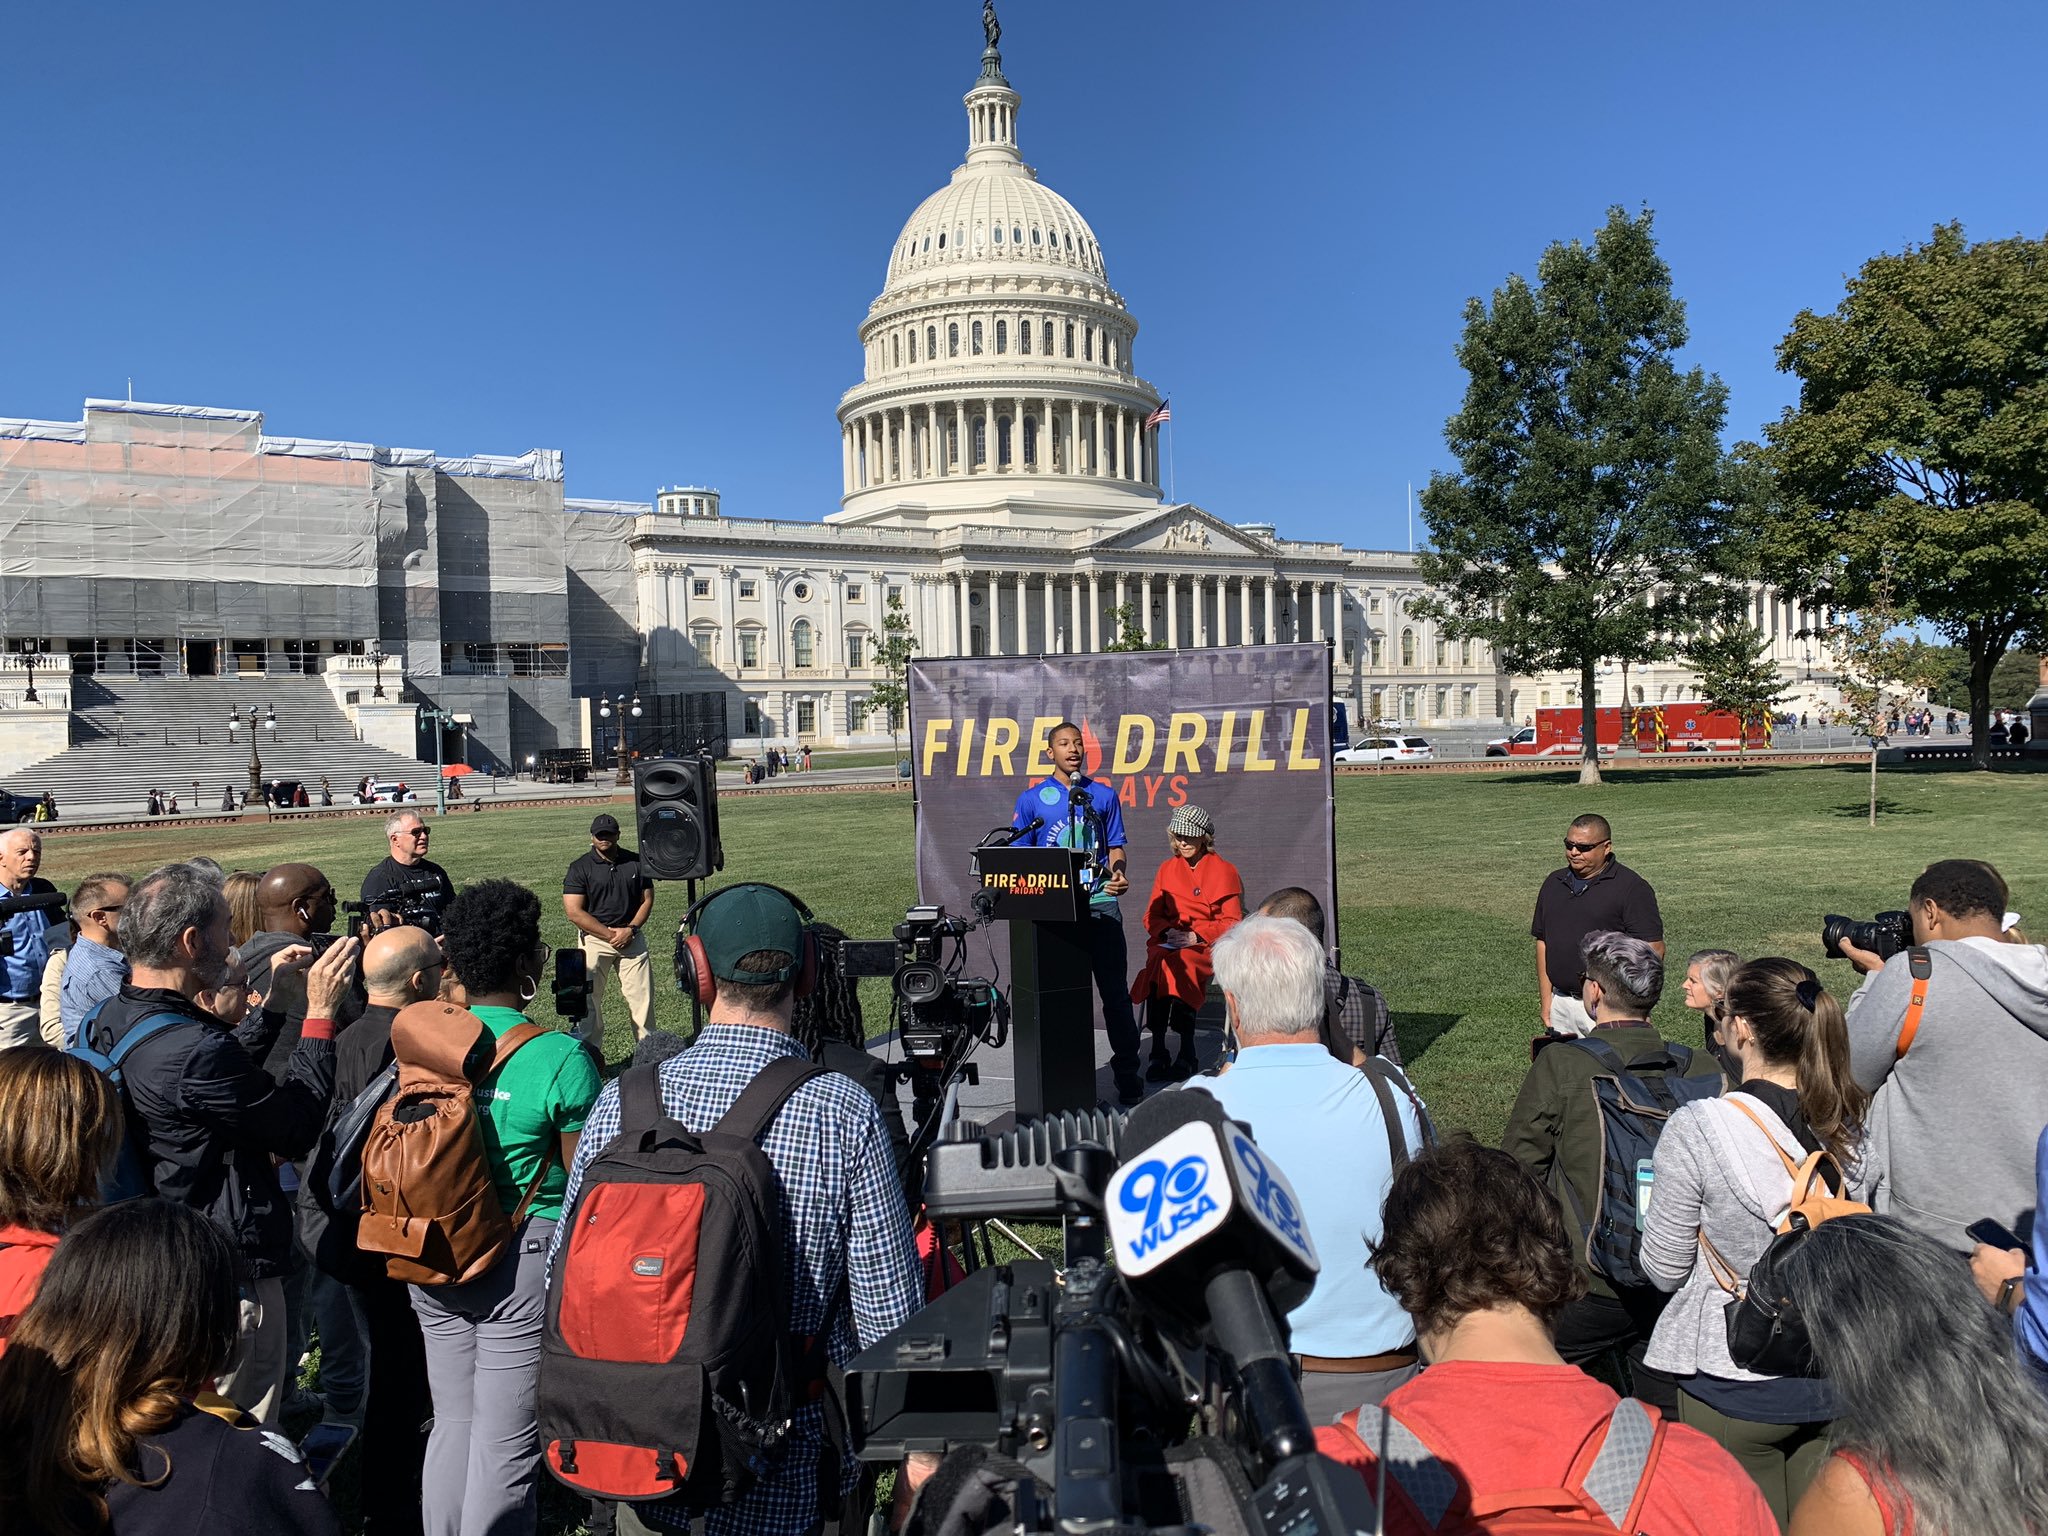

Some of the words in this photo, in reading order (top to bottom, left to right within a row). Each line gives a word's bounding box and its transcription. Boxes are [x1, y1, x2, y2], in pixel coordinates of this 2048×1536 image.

[922, 716, 1063, 777] FIRE
[1112, 708, 1321, 775] DRILL
[985, 873, 1018, 888] FIRE
[1027, 873, 1069, 888] DRILL
[1009, 887, 1045, 895] FRIDAYS
[1129, 1192, 1219, 1260] WUSA
